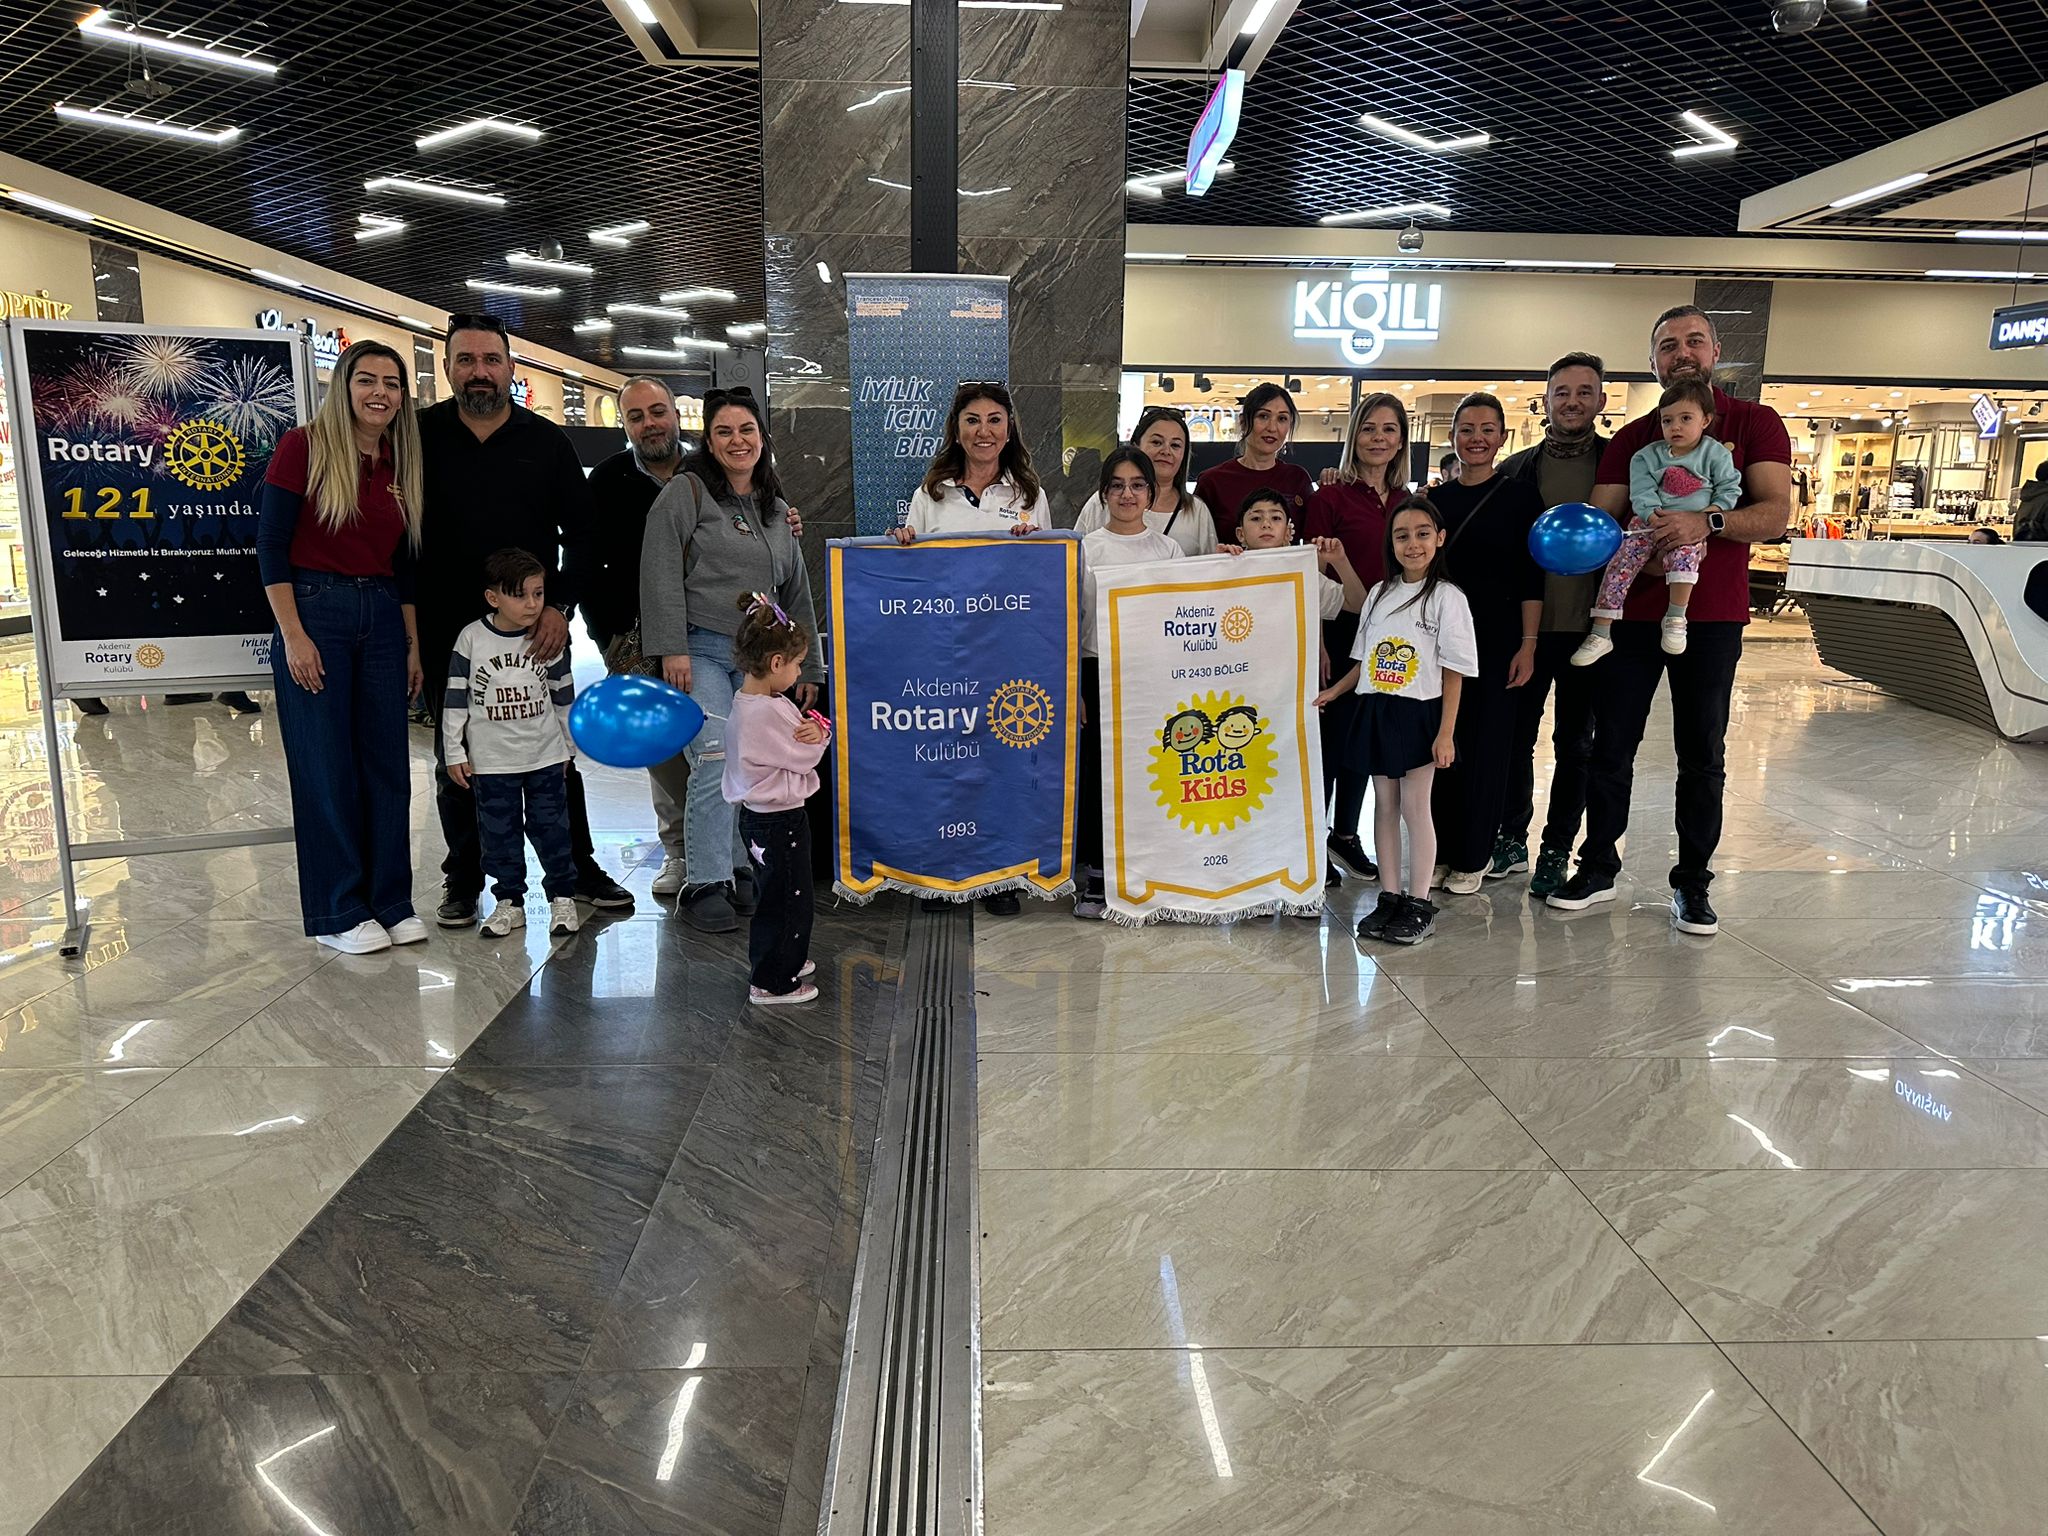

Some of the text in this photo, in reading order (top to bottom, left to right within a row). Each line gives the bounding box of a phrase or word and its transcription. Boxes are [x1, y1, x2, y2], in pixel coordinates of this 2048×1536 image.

[1998, 317, 2048, 343] DANIŞ
[860, 376, 934, 402] İYİLİK
[884, 404, 936, 432] İÇİN
[186, 425, 219, 435] ROTARY
[48, 438, 154, 467] Rotary
[179, 465, 235, 483] INTERNATIONAL
[62, 487, 260, 519] 121 yaşında.
[63, 548, 107, 559] Geleceğe
[109, 548, 149, 557] Hizmetle
[161, 548, 215, 558] Bırakıyoruz:
[216, 547, 241, 556] Mutlu
[242, 547, 257, 555] Yıll
[879, 593, 1031, 615] UR 2430. BÖLGE
[1175, 605, 1215, 618] Akdeniz
[1164, 621, 1217, 637] Rotary
[241, 637, 270, 647] İYİLİK
[1183, 638, 1218, 652] Kulübü
[85, 652, 132, 664] Rotary
[1376, 657, 1407, 672] Rota
[1171, 662, 1249, 679] UR 2430 BÖLGE
[1373, 670, 1405, 684] Kids
[474, 666, 492, 706] ENJOY
[489, 653, 530, 671] WHAT
[902, 677, 979, 697] Akdeniz
[1006, 686, 1034, 695] ROTARY
[871, 701, 979, 734] Rotary
[997, 724, 1044, 741] INTERNATIONAL
[915, 741, 980, 762] Kulübü
[1179, 749, 1246, 776] Rota
[1180, 775, 1247, 803] Kids
[938, 822, 977, 839] 1993
[1203, 854, 1228, 867] 2026
